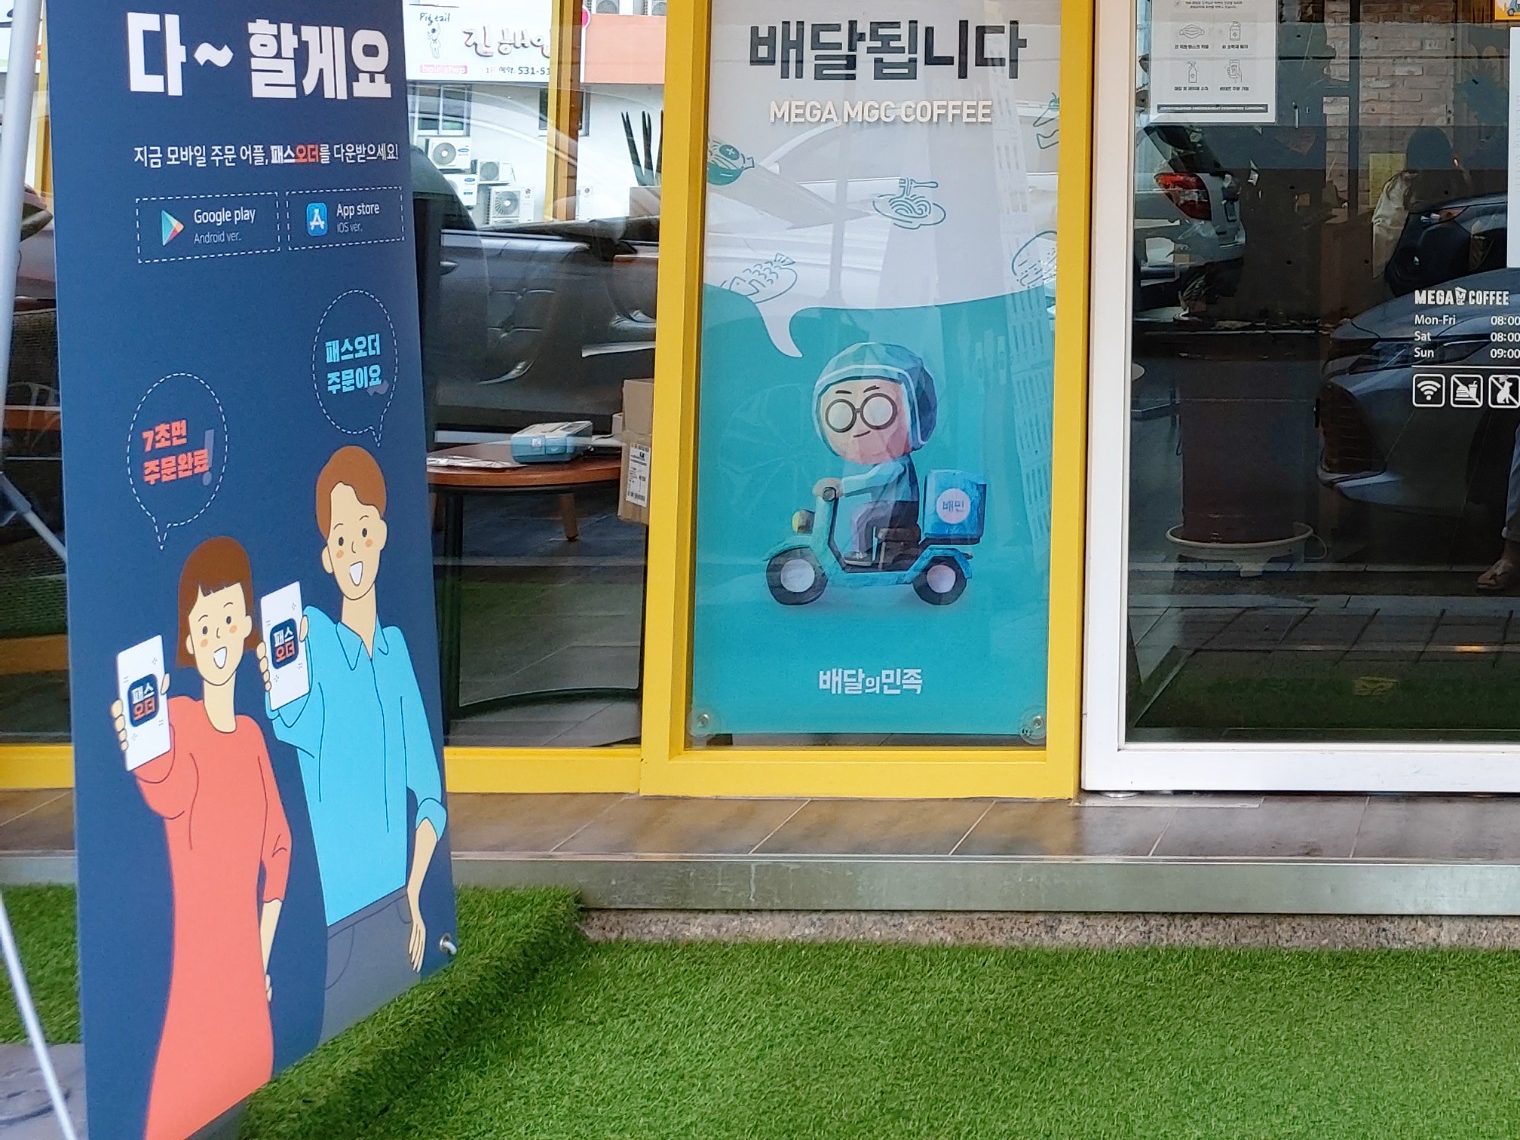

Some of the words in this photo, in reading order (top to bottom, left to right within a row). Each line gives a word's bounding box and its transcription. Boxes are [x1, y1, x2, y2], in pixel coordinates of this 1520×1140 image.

[248, 18, 392, 100] 할게요
[749, 20, 1028, 81] 배달됩니다
[770, 100, 839, 124] MEGA
[843, 100, 897, 124] MGC
[900, 100, 992, 124] COFFEE
[134, 146, 162, 168] 지금
[166, 145, 206, 168] 모바일
[210, 145, 237, 167] 주문
[271, 143, 331, 165] 패스오더를
[333, 143, 399, 161] 다운받으세요!
[194, 209, 231, 224] Google
[234, 208, 256, 225] play
[336, 204, 355, 217] App
[357, 202, 380, 215] store
[194, 231, 225, 244] Android
[1414, 290, 1454, 305] MEGA
[1469, 290, 1509, 306] COFFEE
[1414, 314, 1456, 326] Mon-Fri
[1414, 331, 1431, 342] Sat
[325, 333, 381, 363] 패스오더
[1414, 347, 1435, 358] Sun
[142, 419, 188, 453] 7초면
[942, 499, 965, 513] 배민
[273, 626, 295, 647] 패스
[275, 642, 296, 662] 오더
[818, 668, 923, 696] 배달의민족
[131, 682, 155, 705] 패스
[133, 699, 156, 721] 오더
